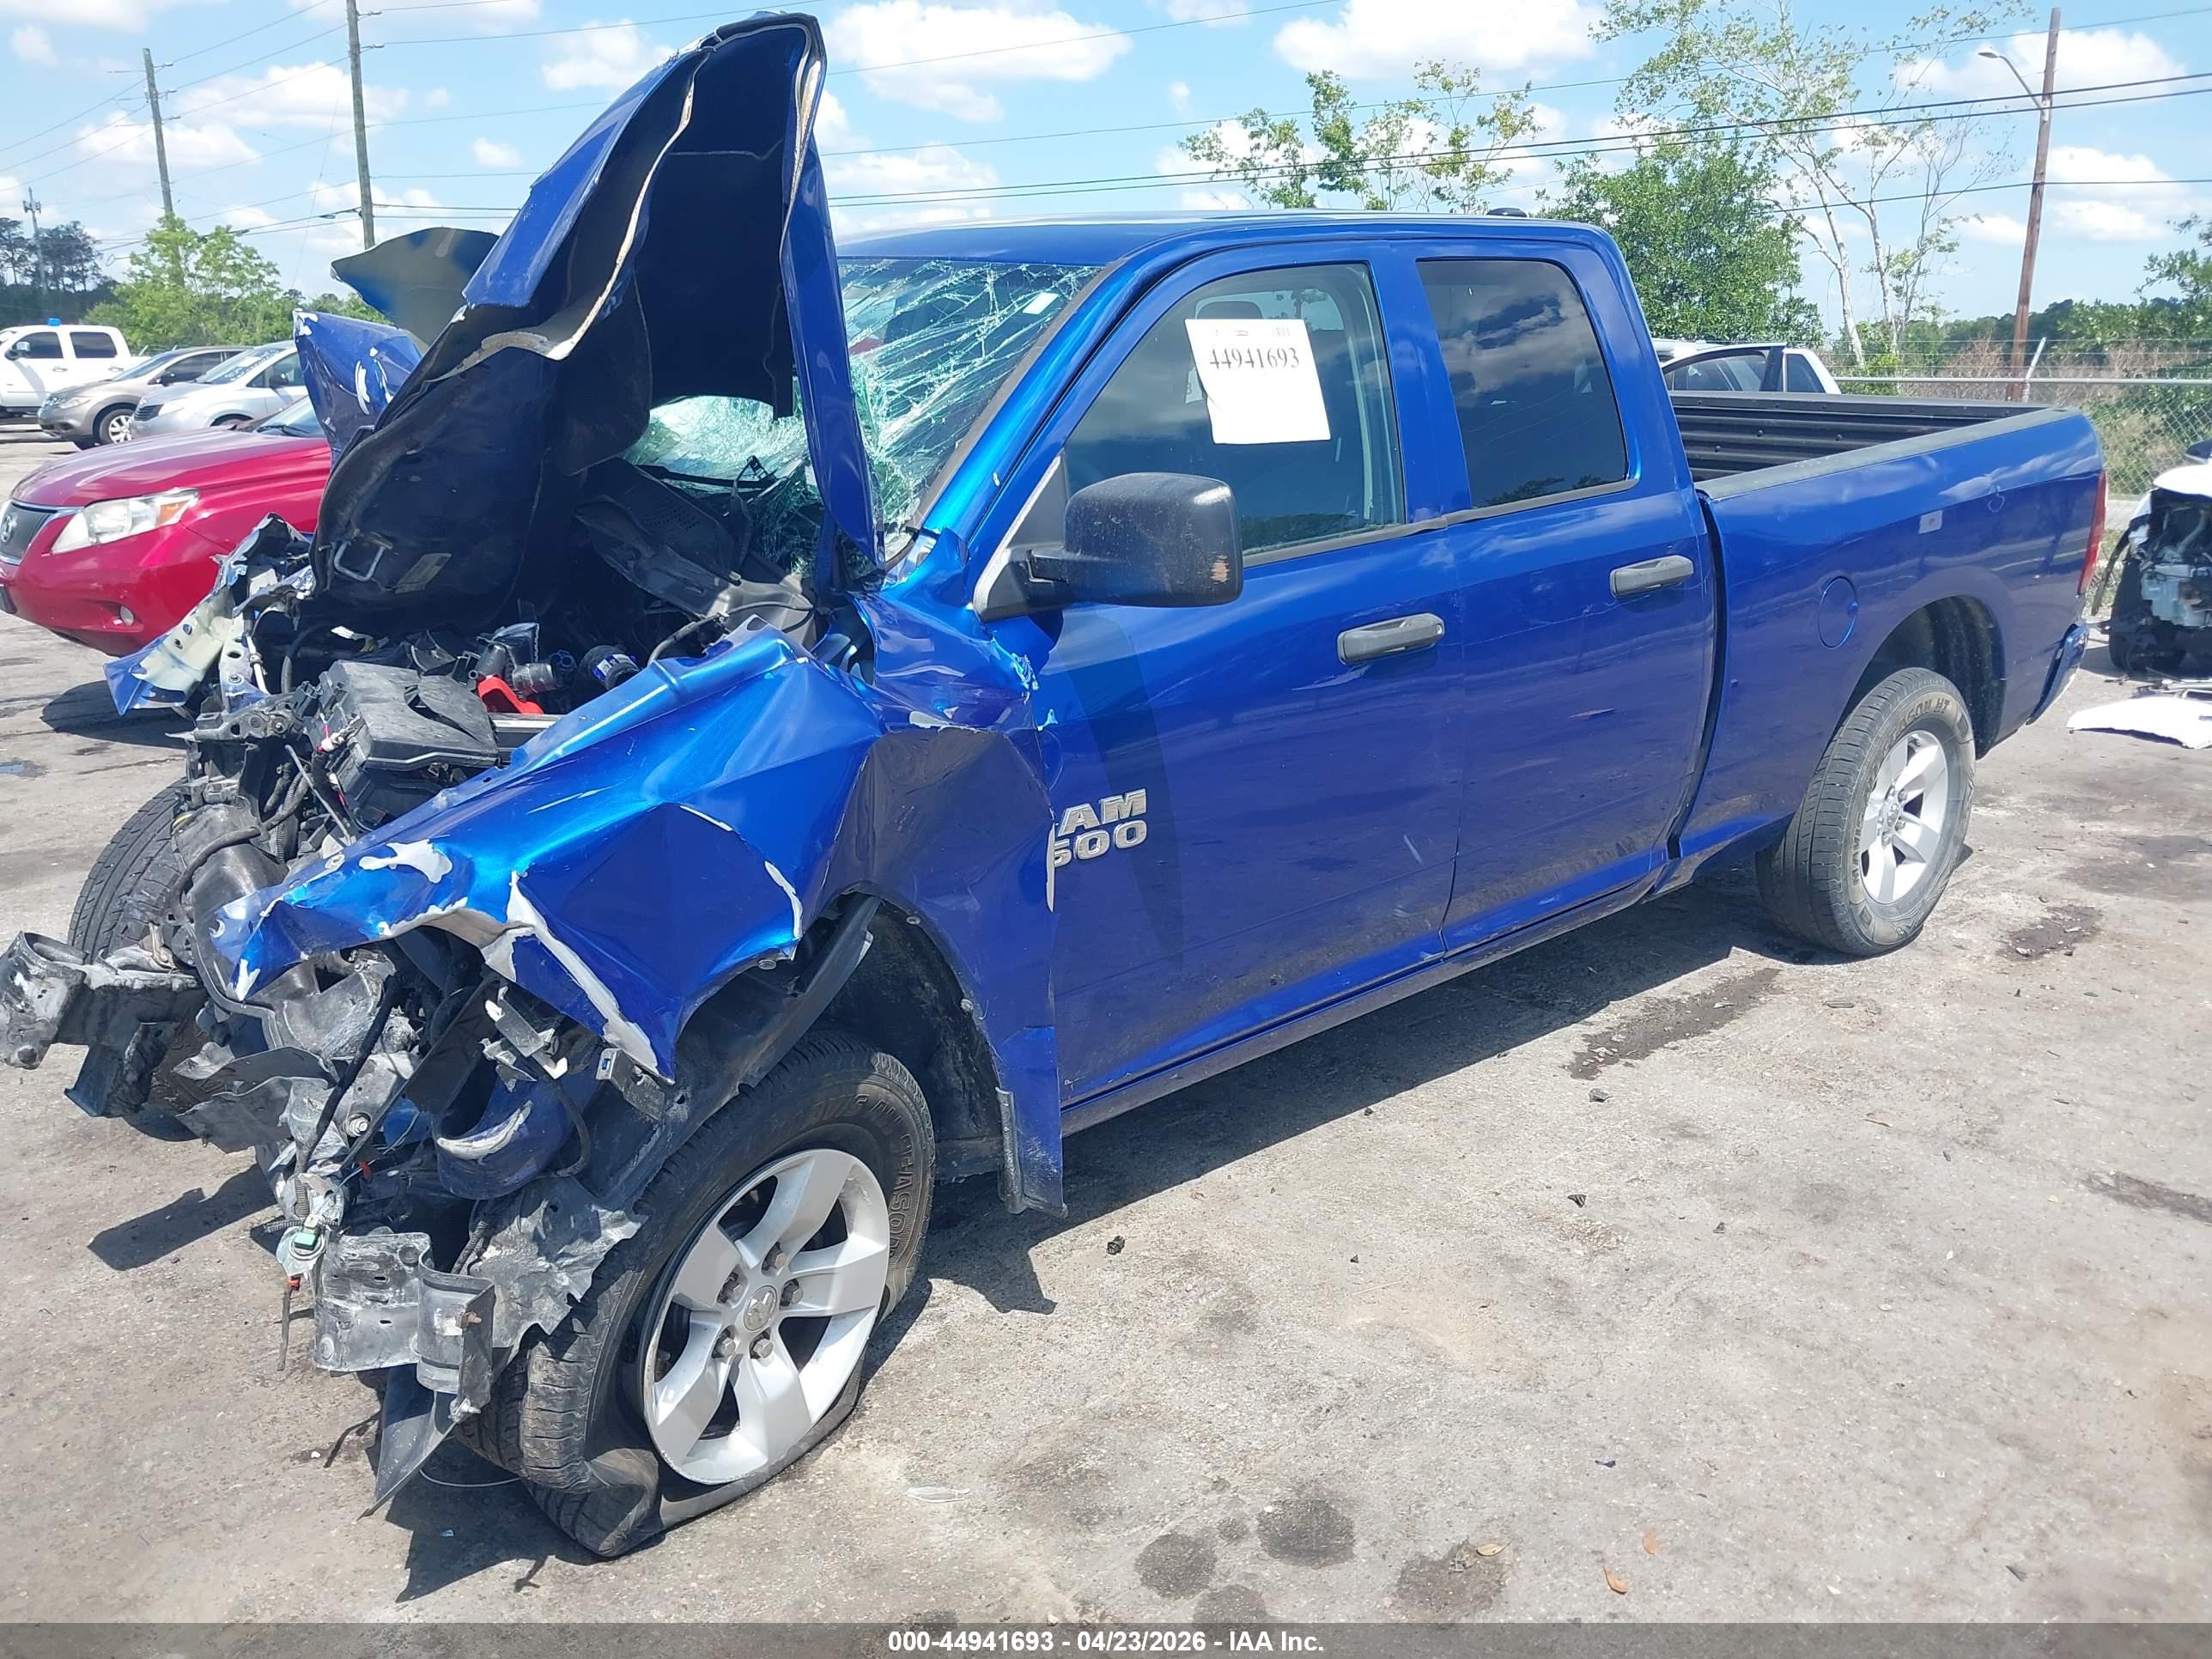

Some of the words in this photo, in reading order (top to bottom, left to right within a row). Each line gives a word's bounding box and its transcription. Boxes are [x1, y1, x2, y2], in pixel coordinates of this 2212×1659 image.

[1208, 347, 1299, 369] 44941693
[1057, 787, 1147, 837] AM
[1054, 819, 1148, 868] 500
